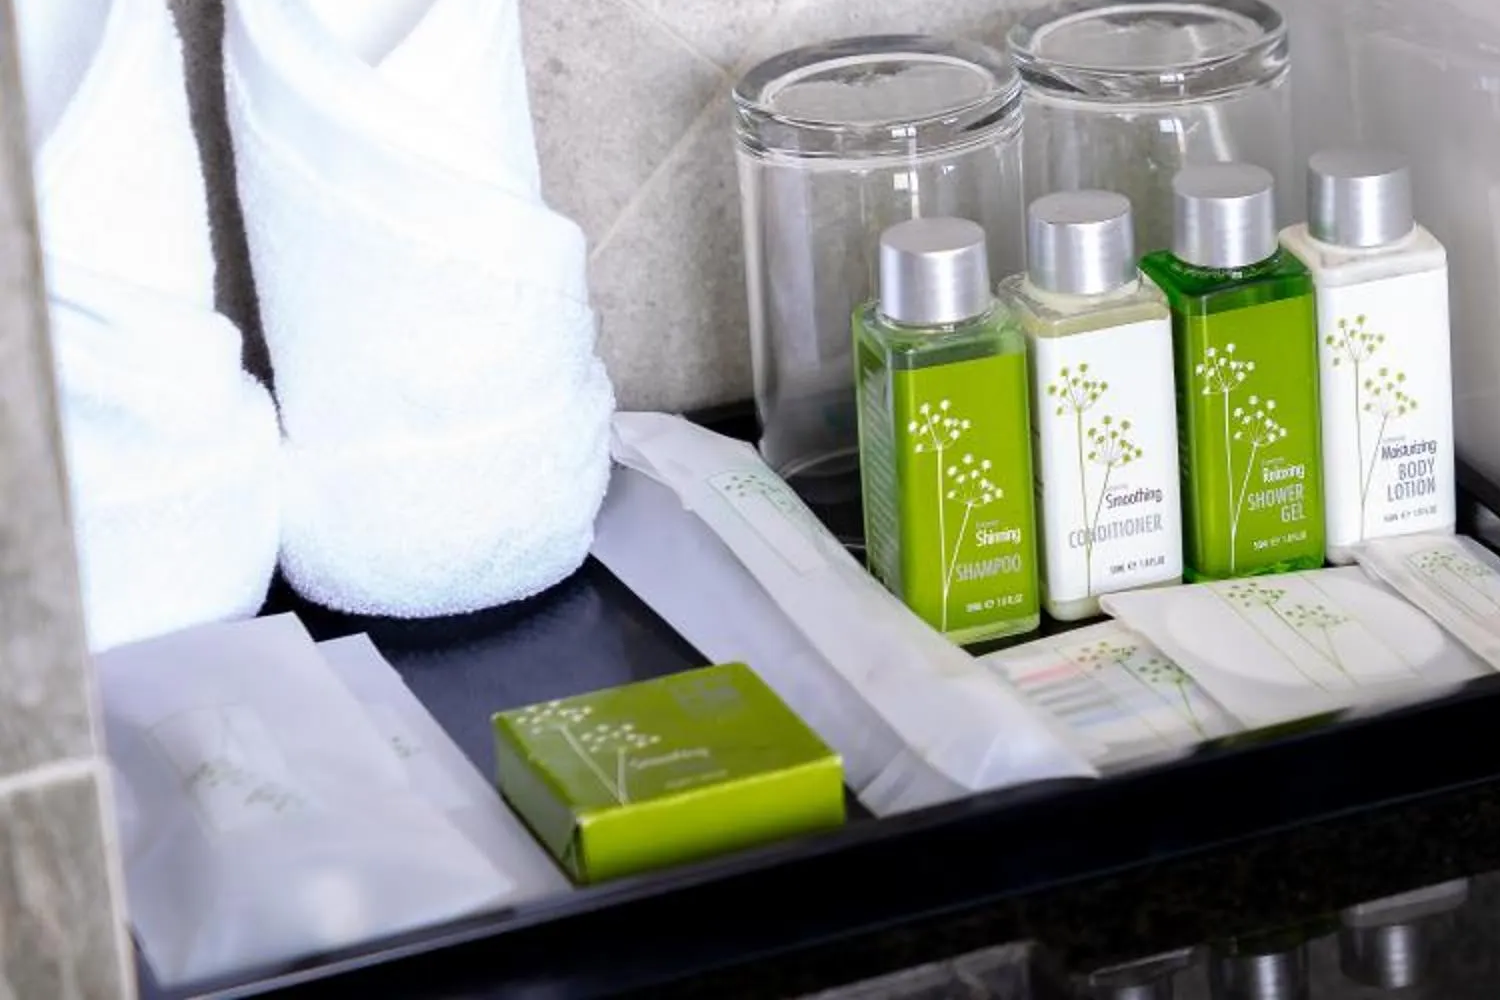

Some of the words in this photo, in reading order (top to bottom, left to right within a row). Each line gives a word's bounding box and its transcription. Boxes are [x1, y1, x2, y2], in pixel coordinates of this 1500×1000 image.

[1398, 456, 1435, 481] BODY
[1105, 488, 1163, 509] Smoothing
[1247, 483, 1304, 511] SHOWER
[1387, 476, 1437, 503] LOTION
[1281, 502, 1307, 523] GEL
[1068, 513, 1163, 549] CONDITIONER
[955, 553, 1022, 582] SHAMPOO
